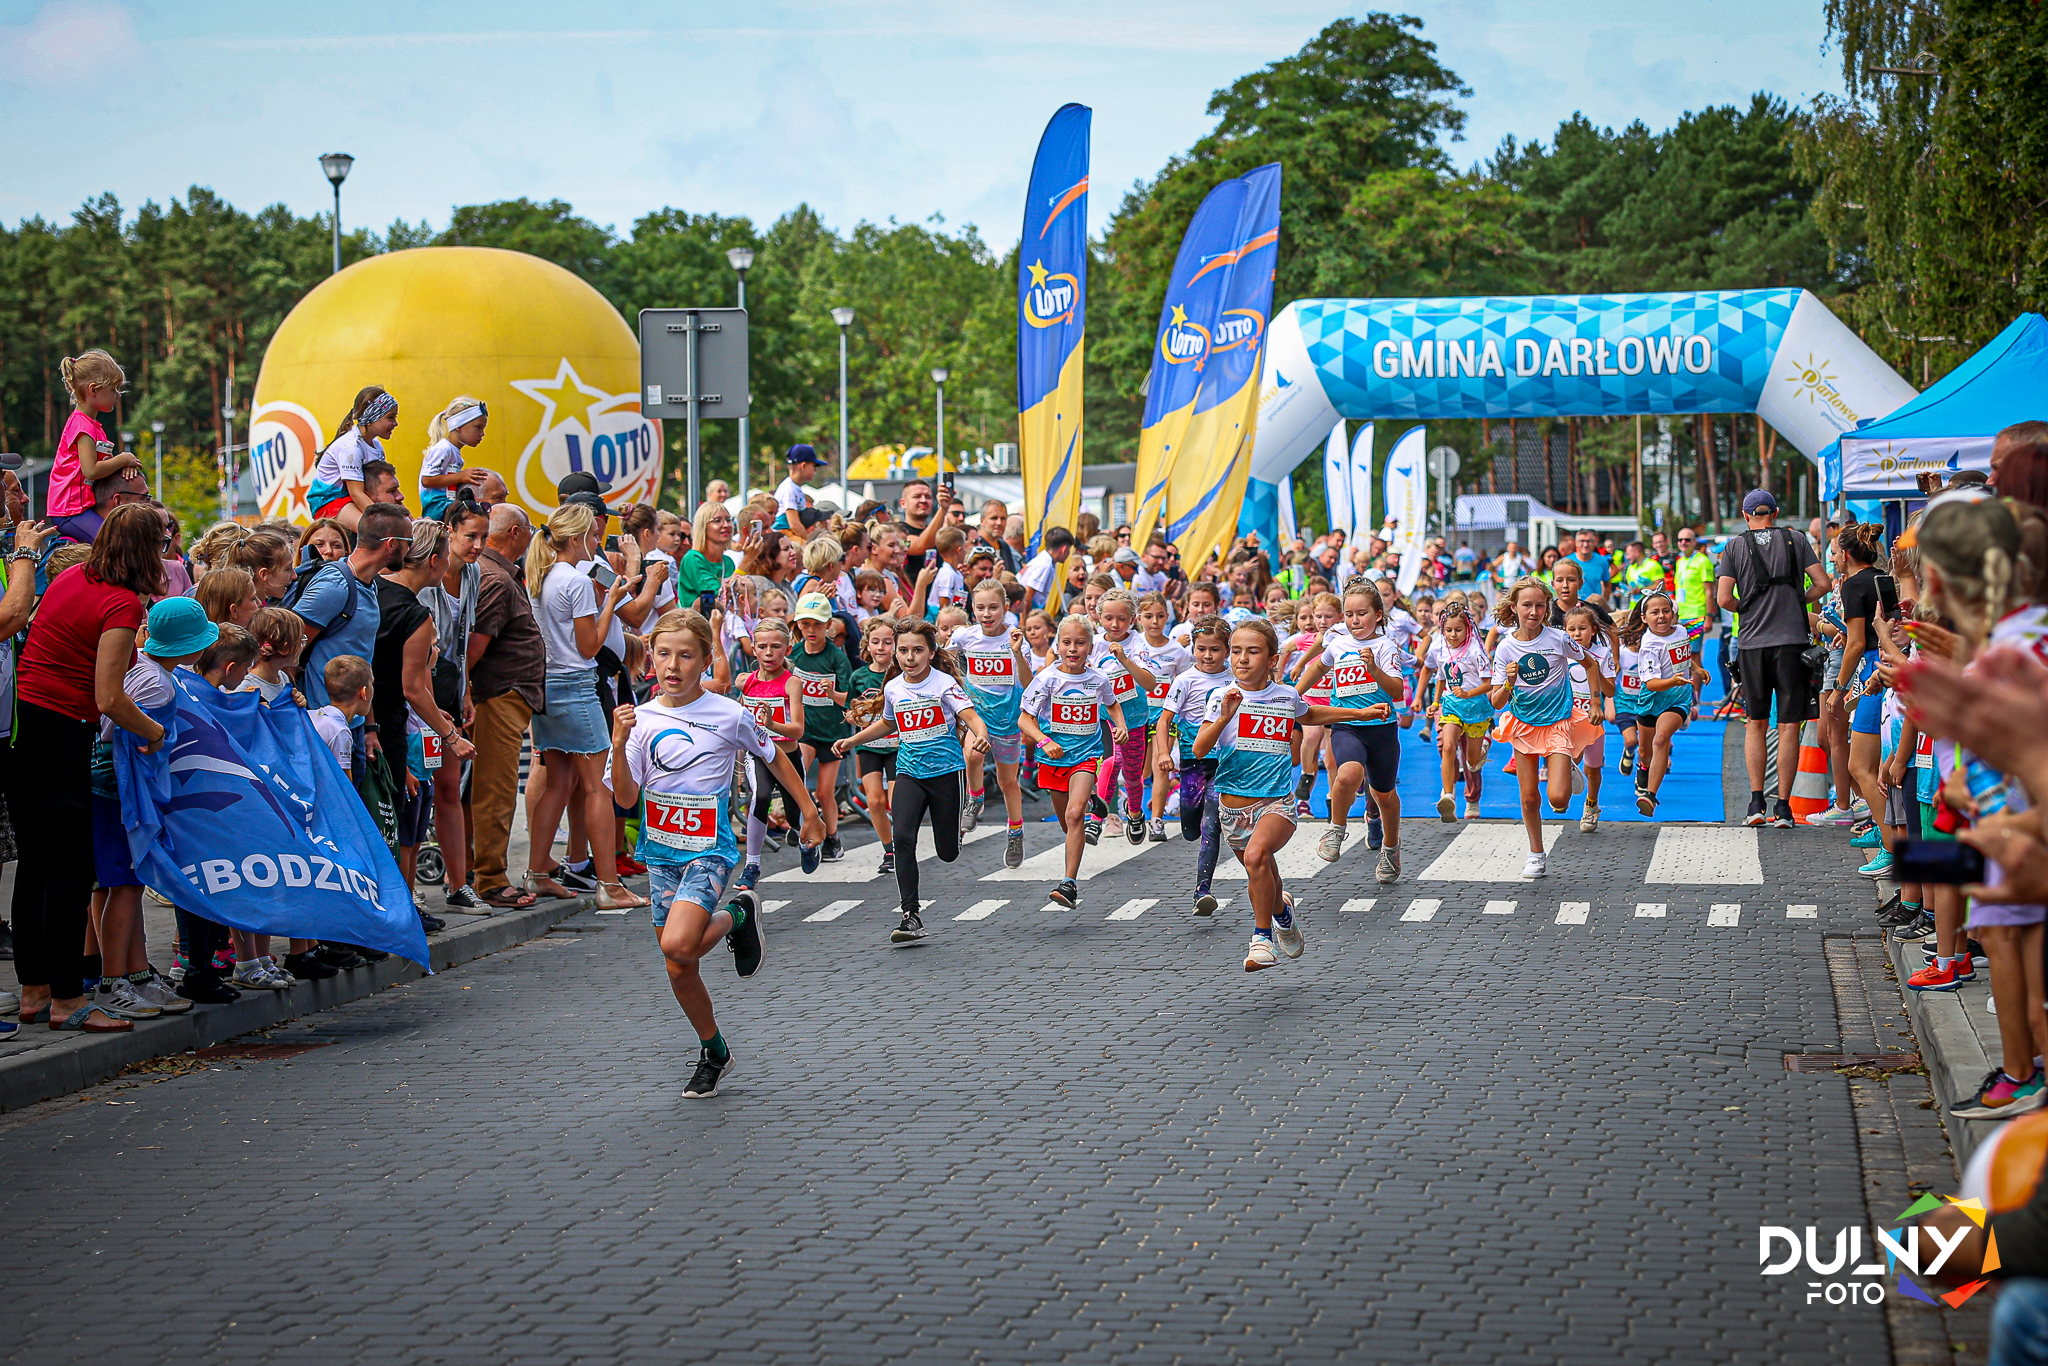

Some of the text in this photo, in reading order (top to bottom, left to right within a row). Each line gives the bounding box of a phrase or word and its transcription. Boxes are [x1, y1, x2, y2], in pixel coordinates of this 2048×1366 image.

[1035, 284, 1072, 317] LOTTO
[1170, 328, 1205, 356] LOTTO
[1214, 317, 1253, 345] OTTO
[1373, 334, 1712, 379] GMINA DARŁOWO
[251, 431, 287, 496] OTTO
[565, 423, 651, 484] LOTTO
[974, 659, 1005, 674] 890
[1338, 666, 1368, 684] 662
[1522, 668, 1547, 680] DUKAT
[1110, 676, 1128, 691] 74
[1060, 704, 1093, 722] 835
[1573, 699, 1591, 712] 36
[902, 708, 936, 729] 879
[1250, 715, 1288, 738] 784
[655, 804, 703, 833] 745
[128, 969, 152, 981] COOL
